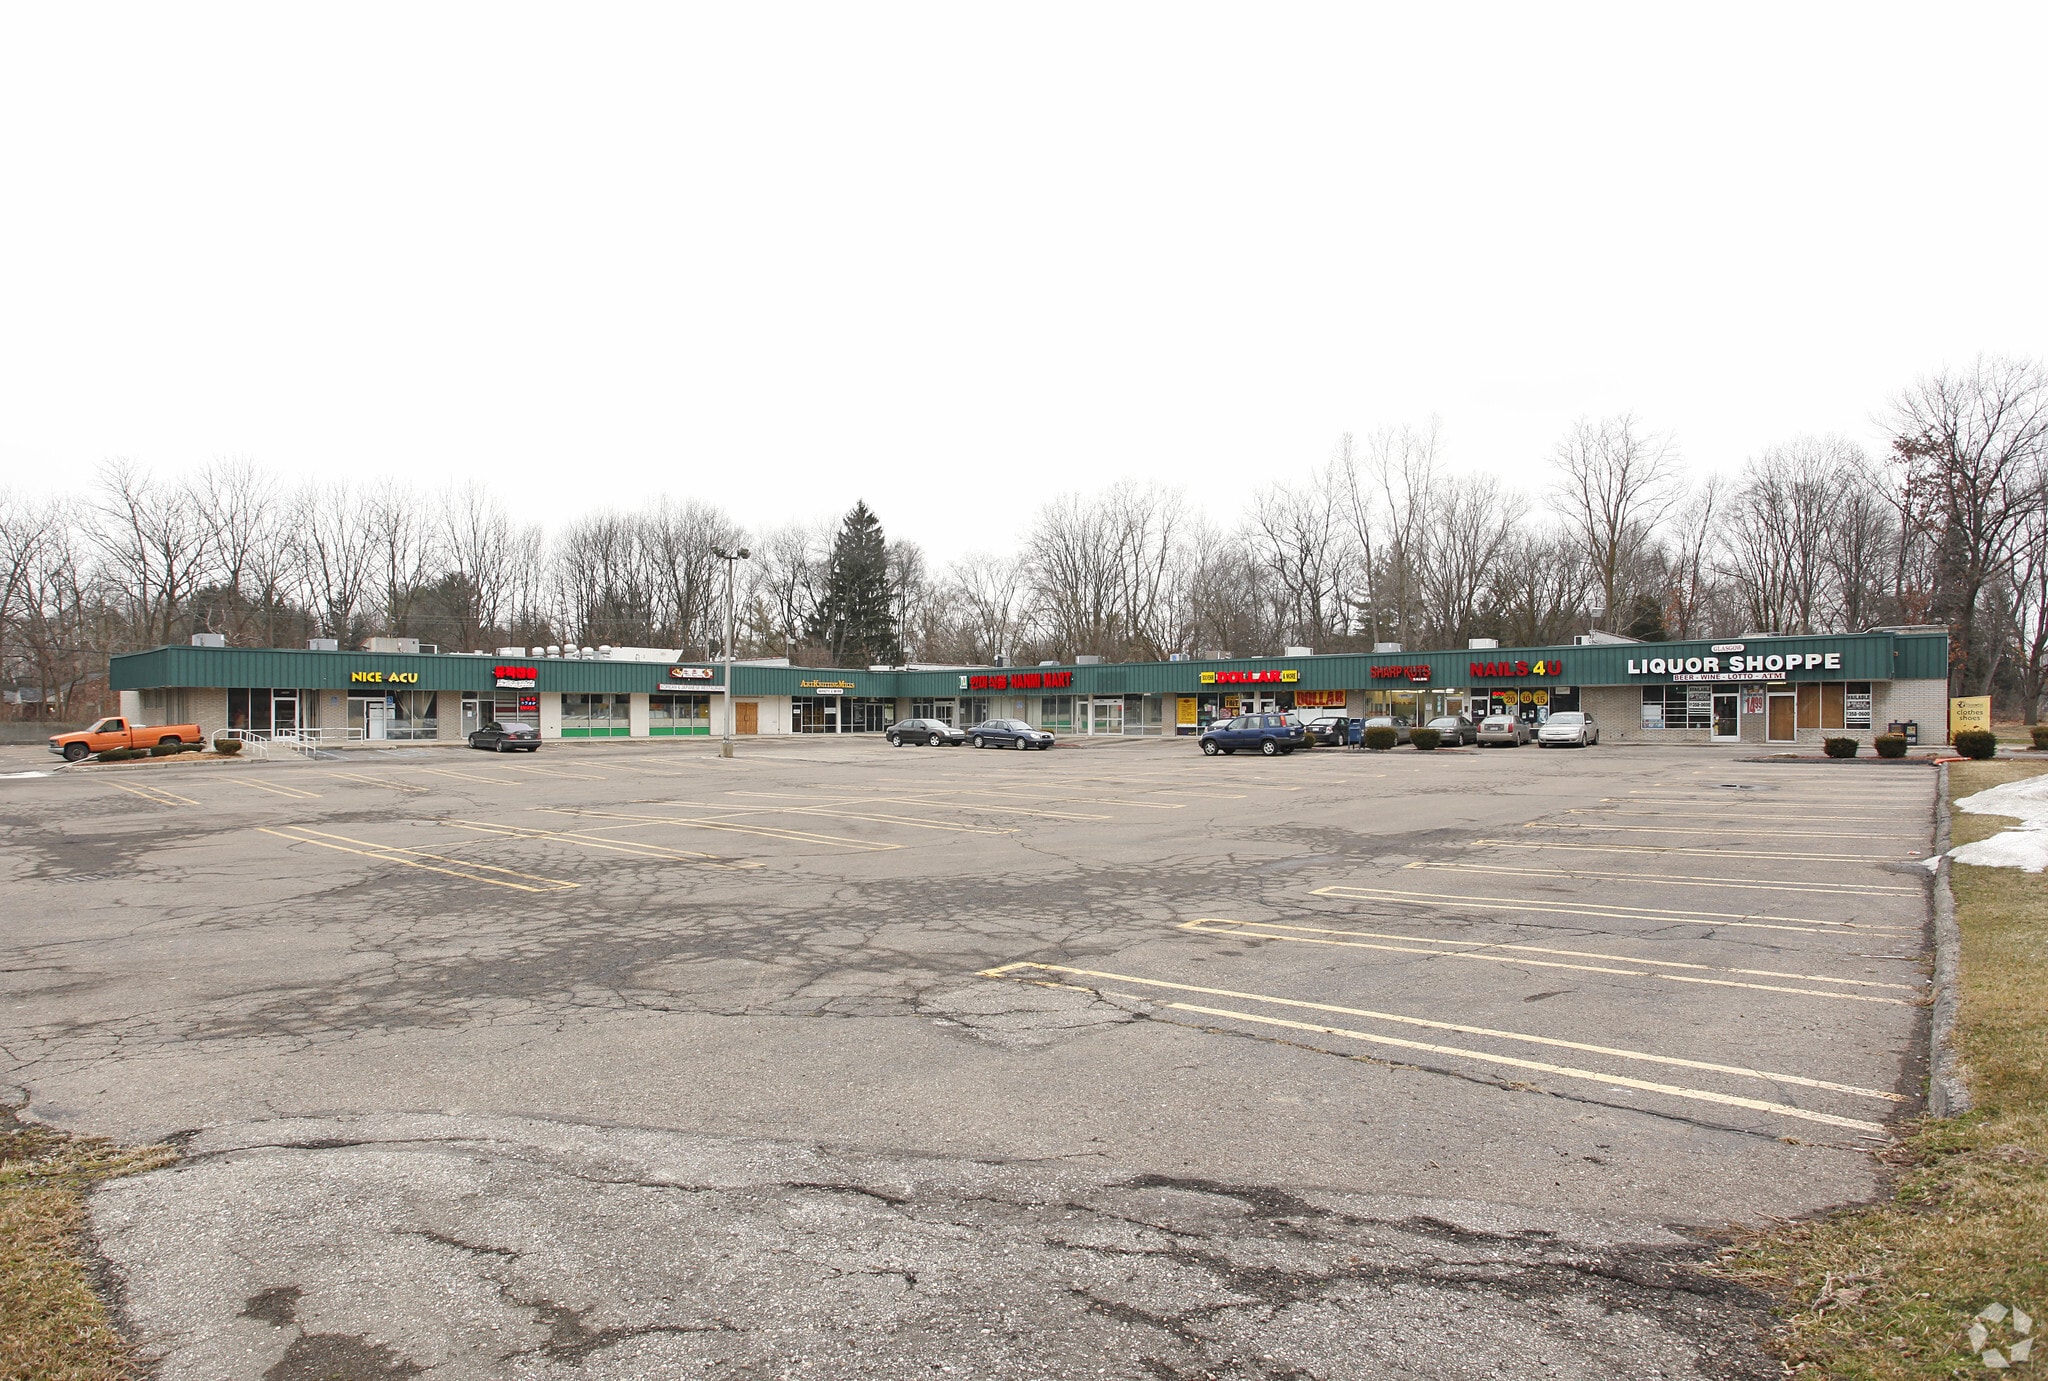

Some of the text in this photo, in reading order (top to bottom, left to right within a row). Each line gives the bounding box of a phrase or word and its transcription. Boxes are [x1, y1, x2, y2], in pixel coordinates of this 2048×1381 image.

[1469, 661, 1529, 677] NAILS
[1627, 653, 1841, 674] LIQUOR SHOPPE
[351, 671, 419, 684] NICE ACU
[1217, 670, 1281, 683] DOLLAR
[1370, 665, 1403, 679] SHARP
[1010, 672, 1072, 689] HANMI MART
[1297, 691, 1343, 705] DOLLAR
